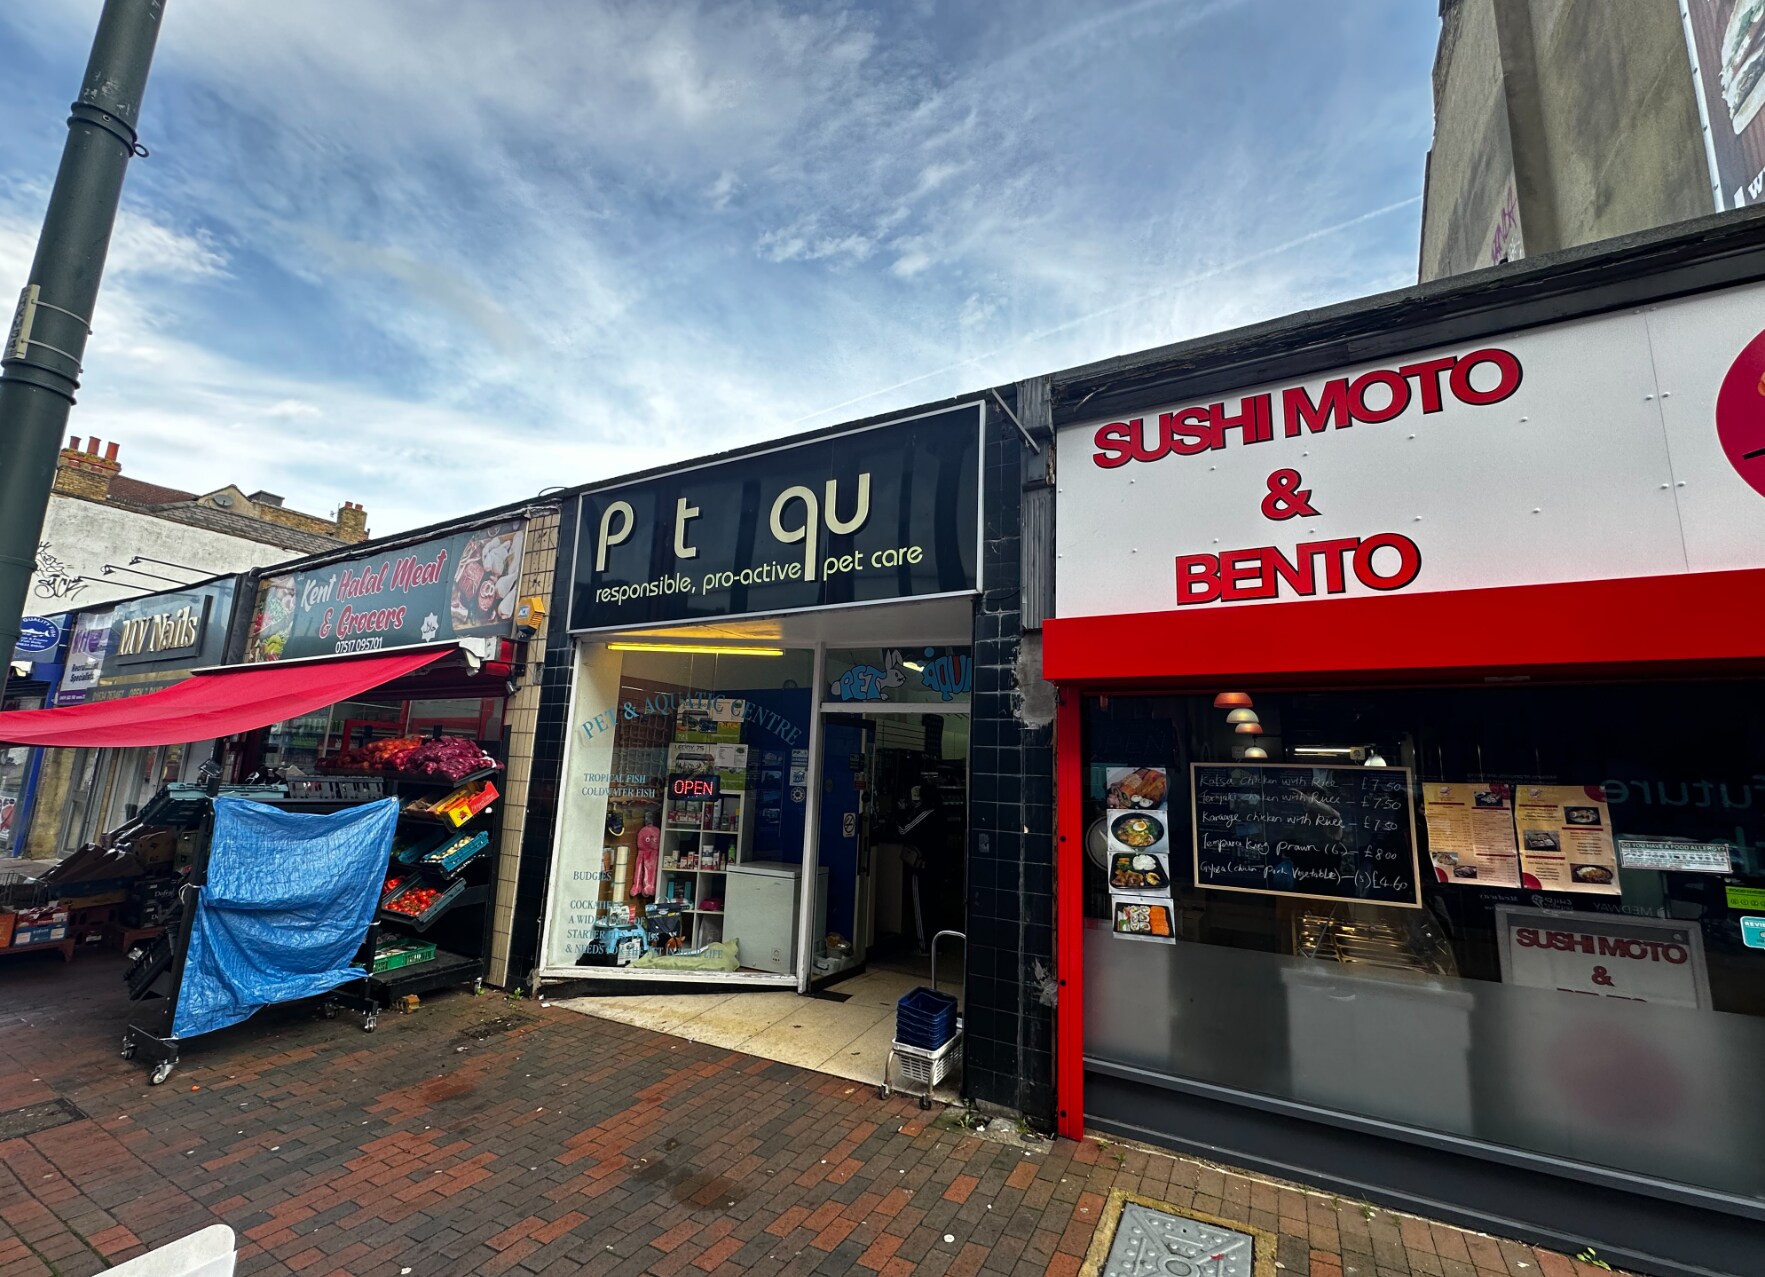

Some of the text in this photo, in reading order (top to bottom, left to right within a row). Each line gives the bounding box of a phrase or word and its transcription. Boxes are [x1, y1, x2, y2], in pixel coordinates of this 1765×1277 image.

[1092, 348, 1523, 469] SUSHI MOTO
[1261, 467, 1321, 521] &
[595, 545, 924, 606] responsible, pro-active pet care
[1175, 532, 1421, 606] BENTO
[300, 549, 448, 612] Kent Halal Meat
[147, 605, 198, 652] Nails
[319, 604, 407, 640] & Grocers
[335, 640, 356, 654] 07517
[840, 664, 886, 700] PET
[581, 690, 803, 746] PET & AQUATIC CENTRE
[583, 772, 646, 784] TROPICAL FISH
[673, 779, 715, 796] OPEN
[1281, 776, 1307, 786] with
[1312, 777, 1339, 788] Rice
[581, 786, 656, 798] COLDWATER FISH
[1287, 813, 1311, 826] with
[1316, 814, 1345, 828] Rice
[1202, 832, 1242, 853] Tempura
[573, 870, 612, 881] BUDGIES
[568, 915, 575, 924] A
[567, 929, 605, 939] STARTER
[565, 944, 573, 953] &
[574, 945, 604, 954] NEEDS
[1516, 928, 1688, 964] SUSHI MOTO
[1592, 966, 1615, 987] &
